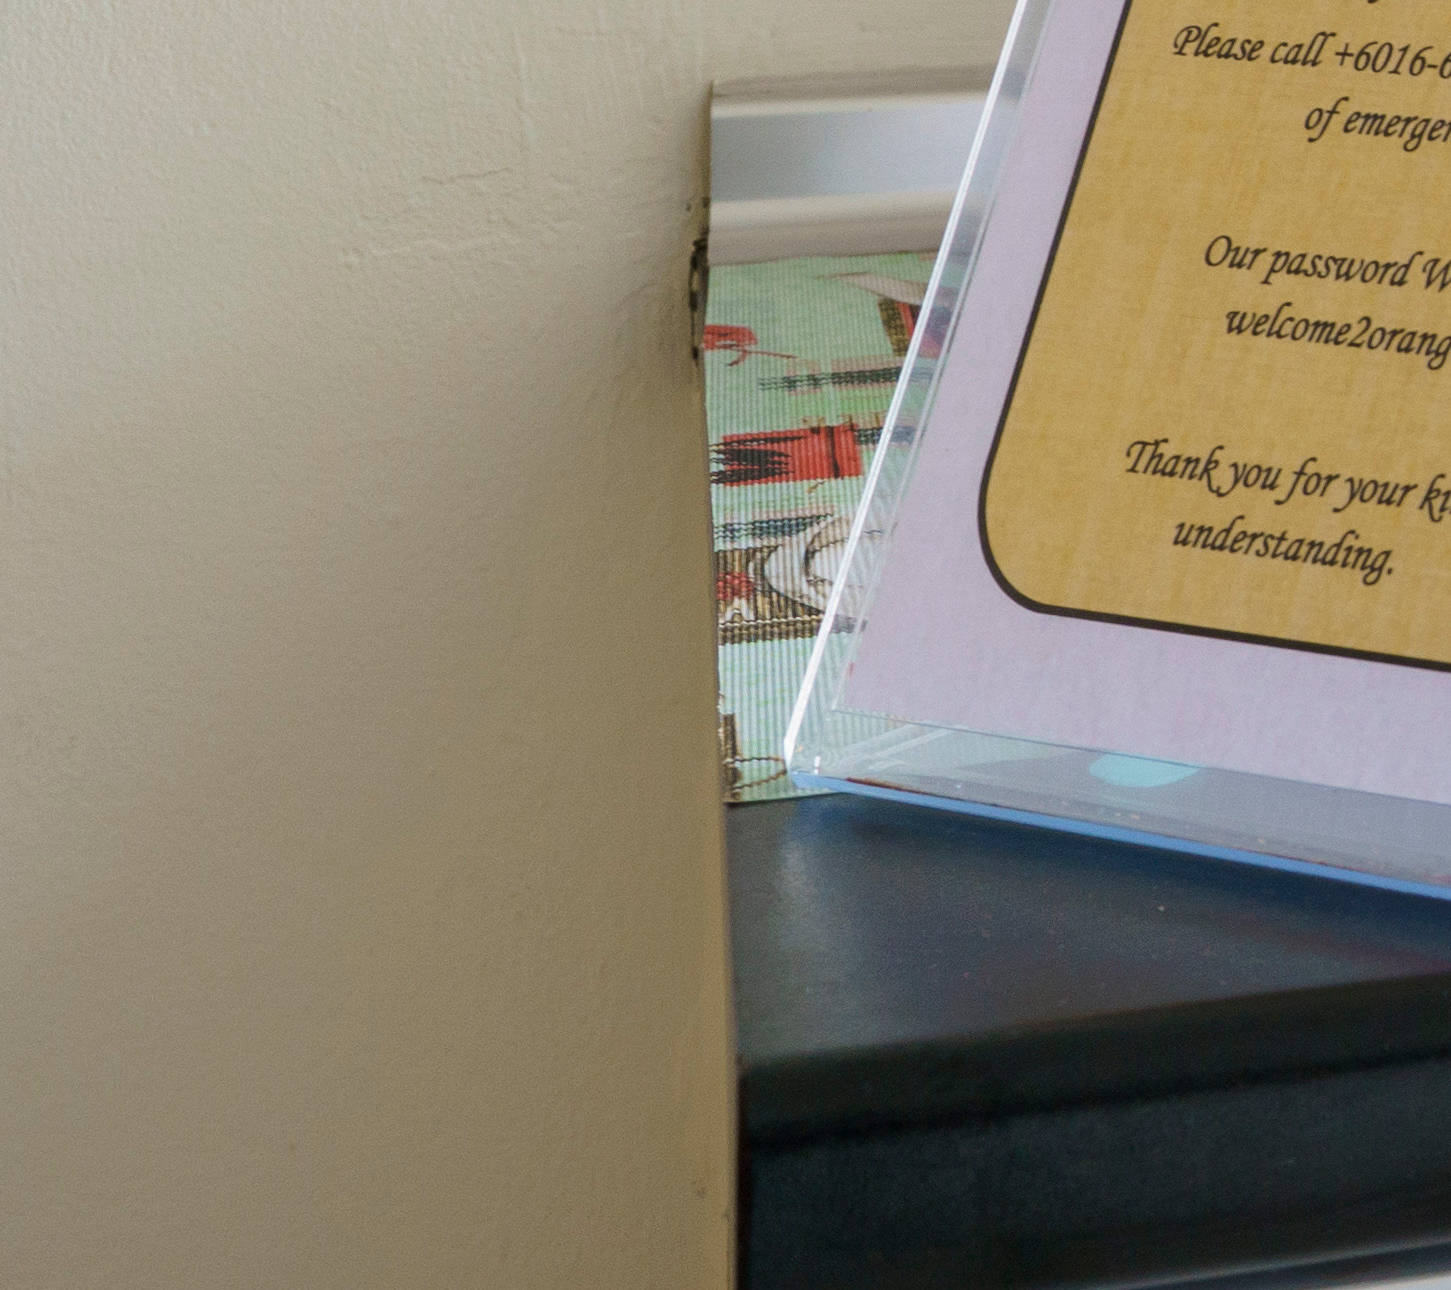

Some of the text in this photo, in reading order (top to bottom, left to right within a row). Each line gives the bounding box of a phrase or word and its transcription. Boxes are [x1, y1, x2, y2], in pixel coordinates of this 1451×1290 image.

[1173, 22, 1265, 62] Please
[1269, 30, 1337, 68] call
[1304, 95, 1350, 144] of
[1204, 234, 1268, 270] Our
[1261, 250, 1425, 288] password
[1125, 437, 1226, 495] Thank
[1221, 453, 1282, 498] you
[1274, 456, 1341, 506] for
[1332, 476, 1419, 514] your
[1172, 514, 1393, 587] understanding.
